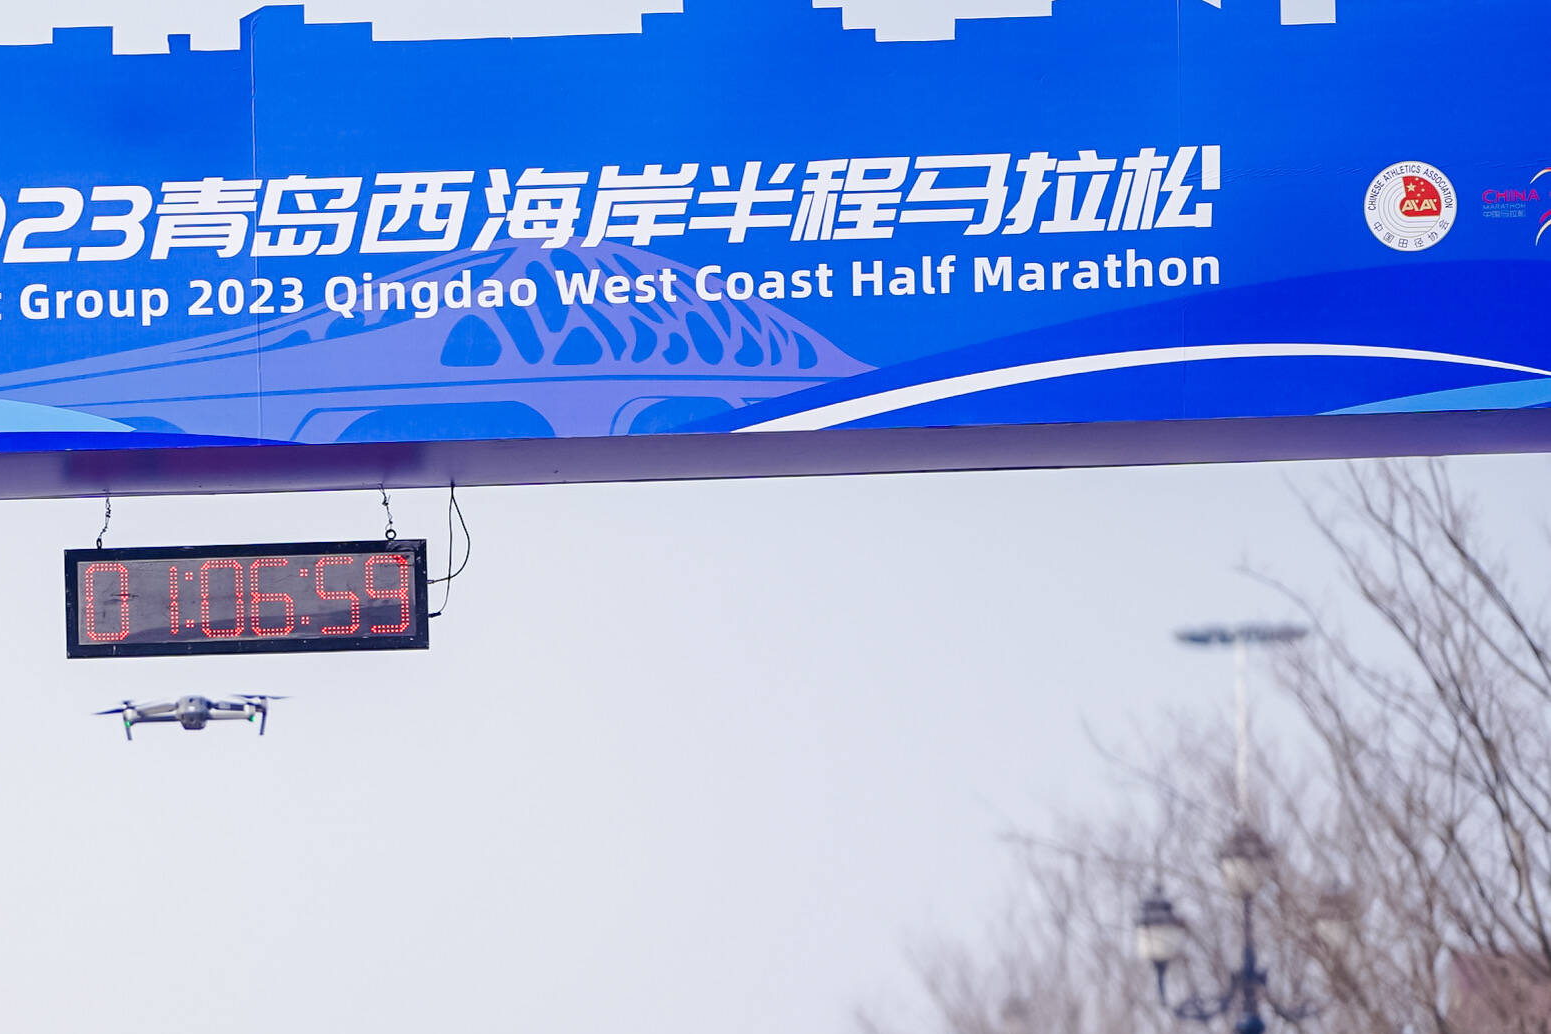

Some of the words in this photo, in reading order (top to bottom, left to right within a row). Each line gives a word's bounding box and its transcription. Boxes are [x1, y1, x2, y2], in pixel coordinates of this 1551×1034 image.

[1383, 165, 1421, 182] ATHLETICS
[1423, 168, 1453, 209] ASSOCIATION
[1482, 189, 1540, 204] CHINA
[20, 283, 169, 326] Group
[188, 277, 304, 316] 2023
[325, 269, 537, 319] Qingdao
[554, 268, 677, 305] West
[695, 263, 833, 301] Coast
[852, 255, 956, 297] Half
[974, 248, 1219, 293] Marathon
[85, 554, 411, 641] 01:06:59
